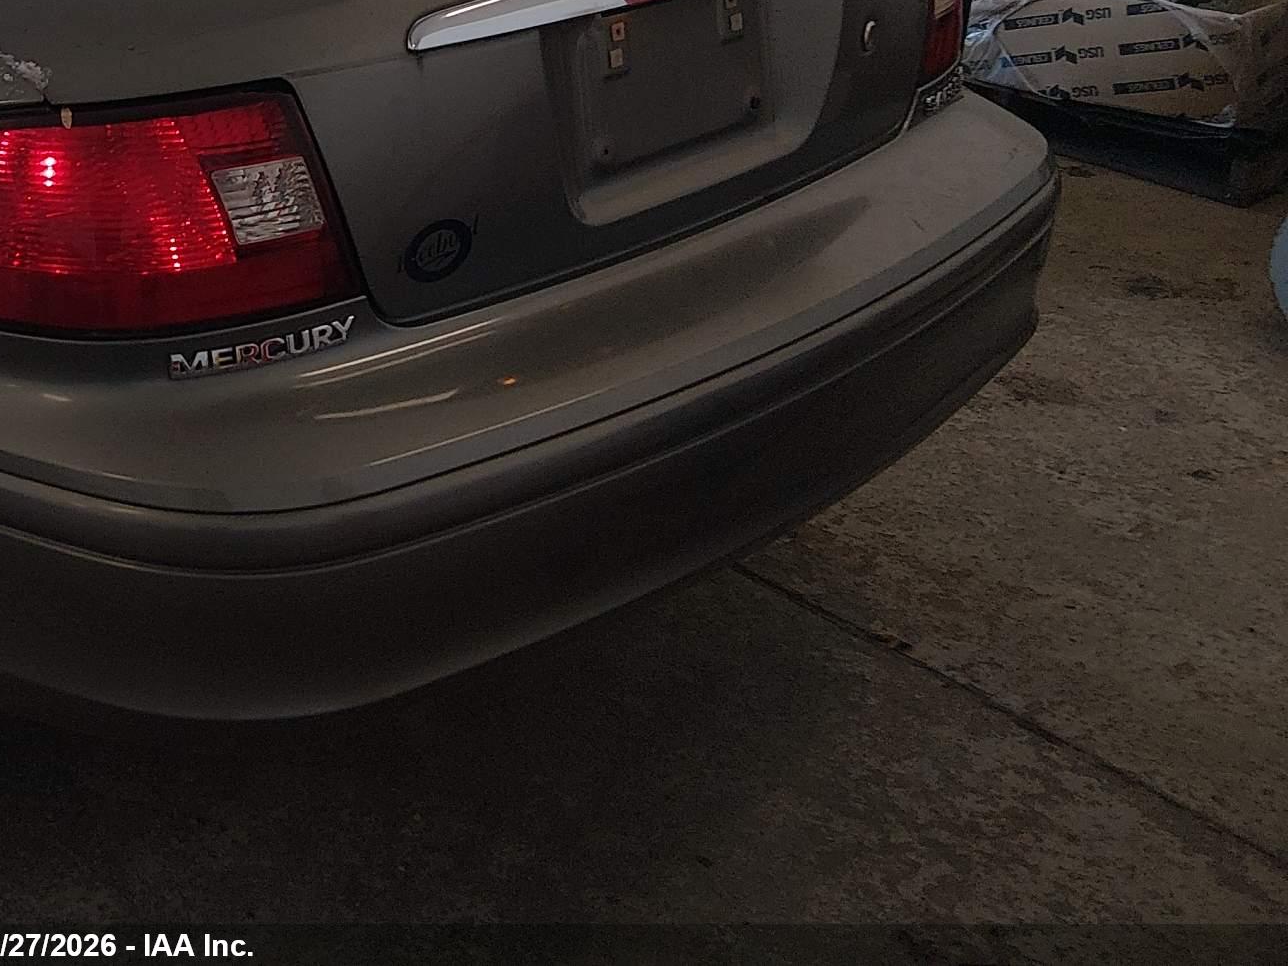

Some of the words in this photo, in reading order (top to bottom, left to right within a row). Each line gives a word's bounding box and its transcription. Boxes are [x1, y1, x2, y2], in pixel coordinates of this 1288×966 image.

[1086, 7, 1111, 20] USG
[1078, 46, 1104, 59] USG
[1072, 85, 1099, 98] USG
[169, 315, 355, 380] MERCURY
